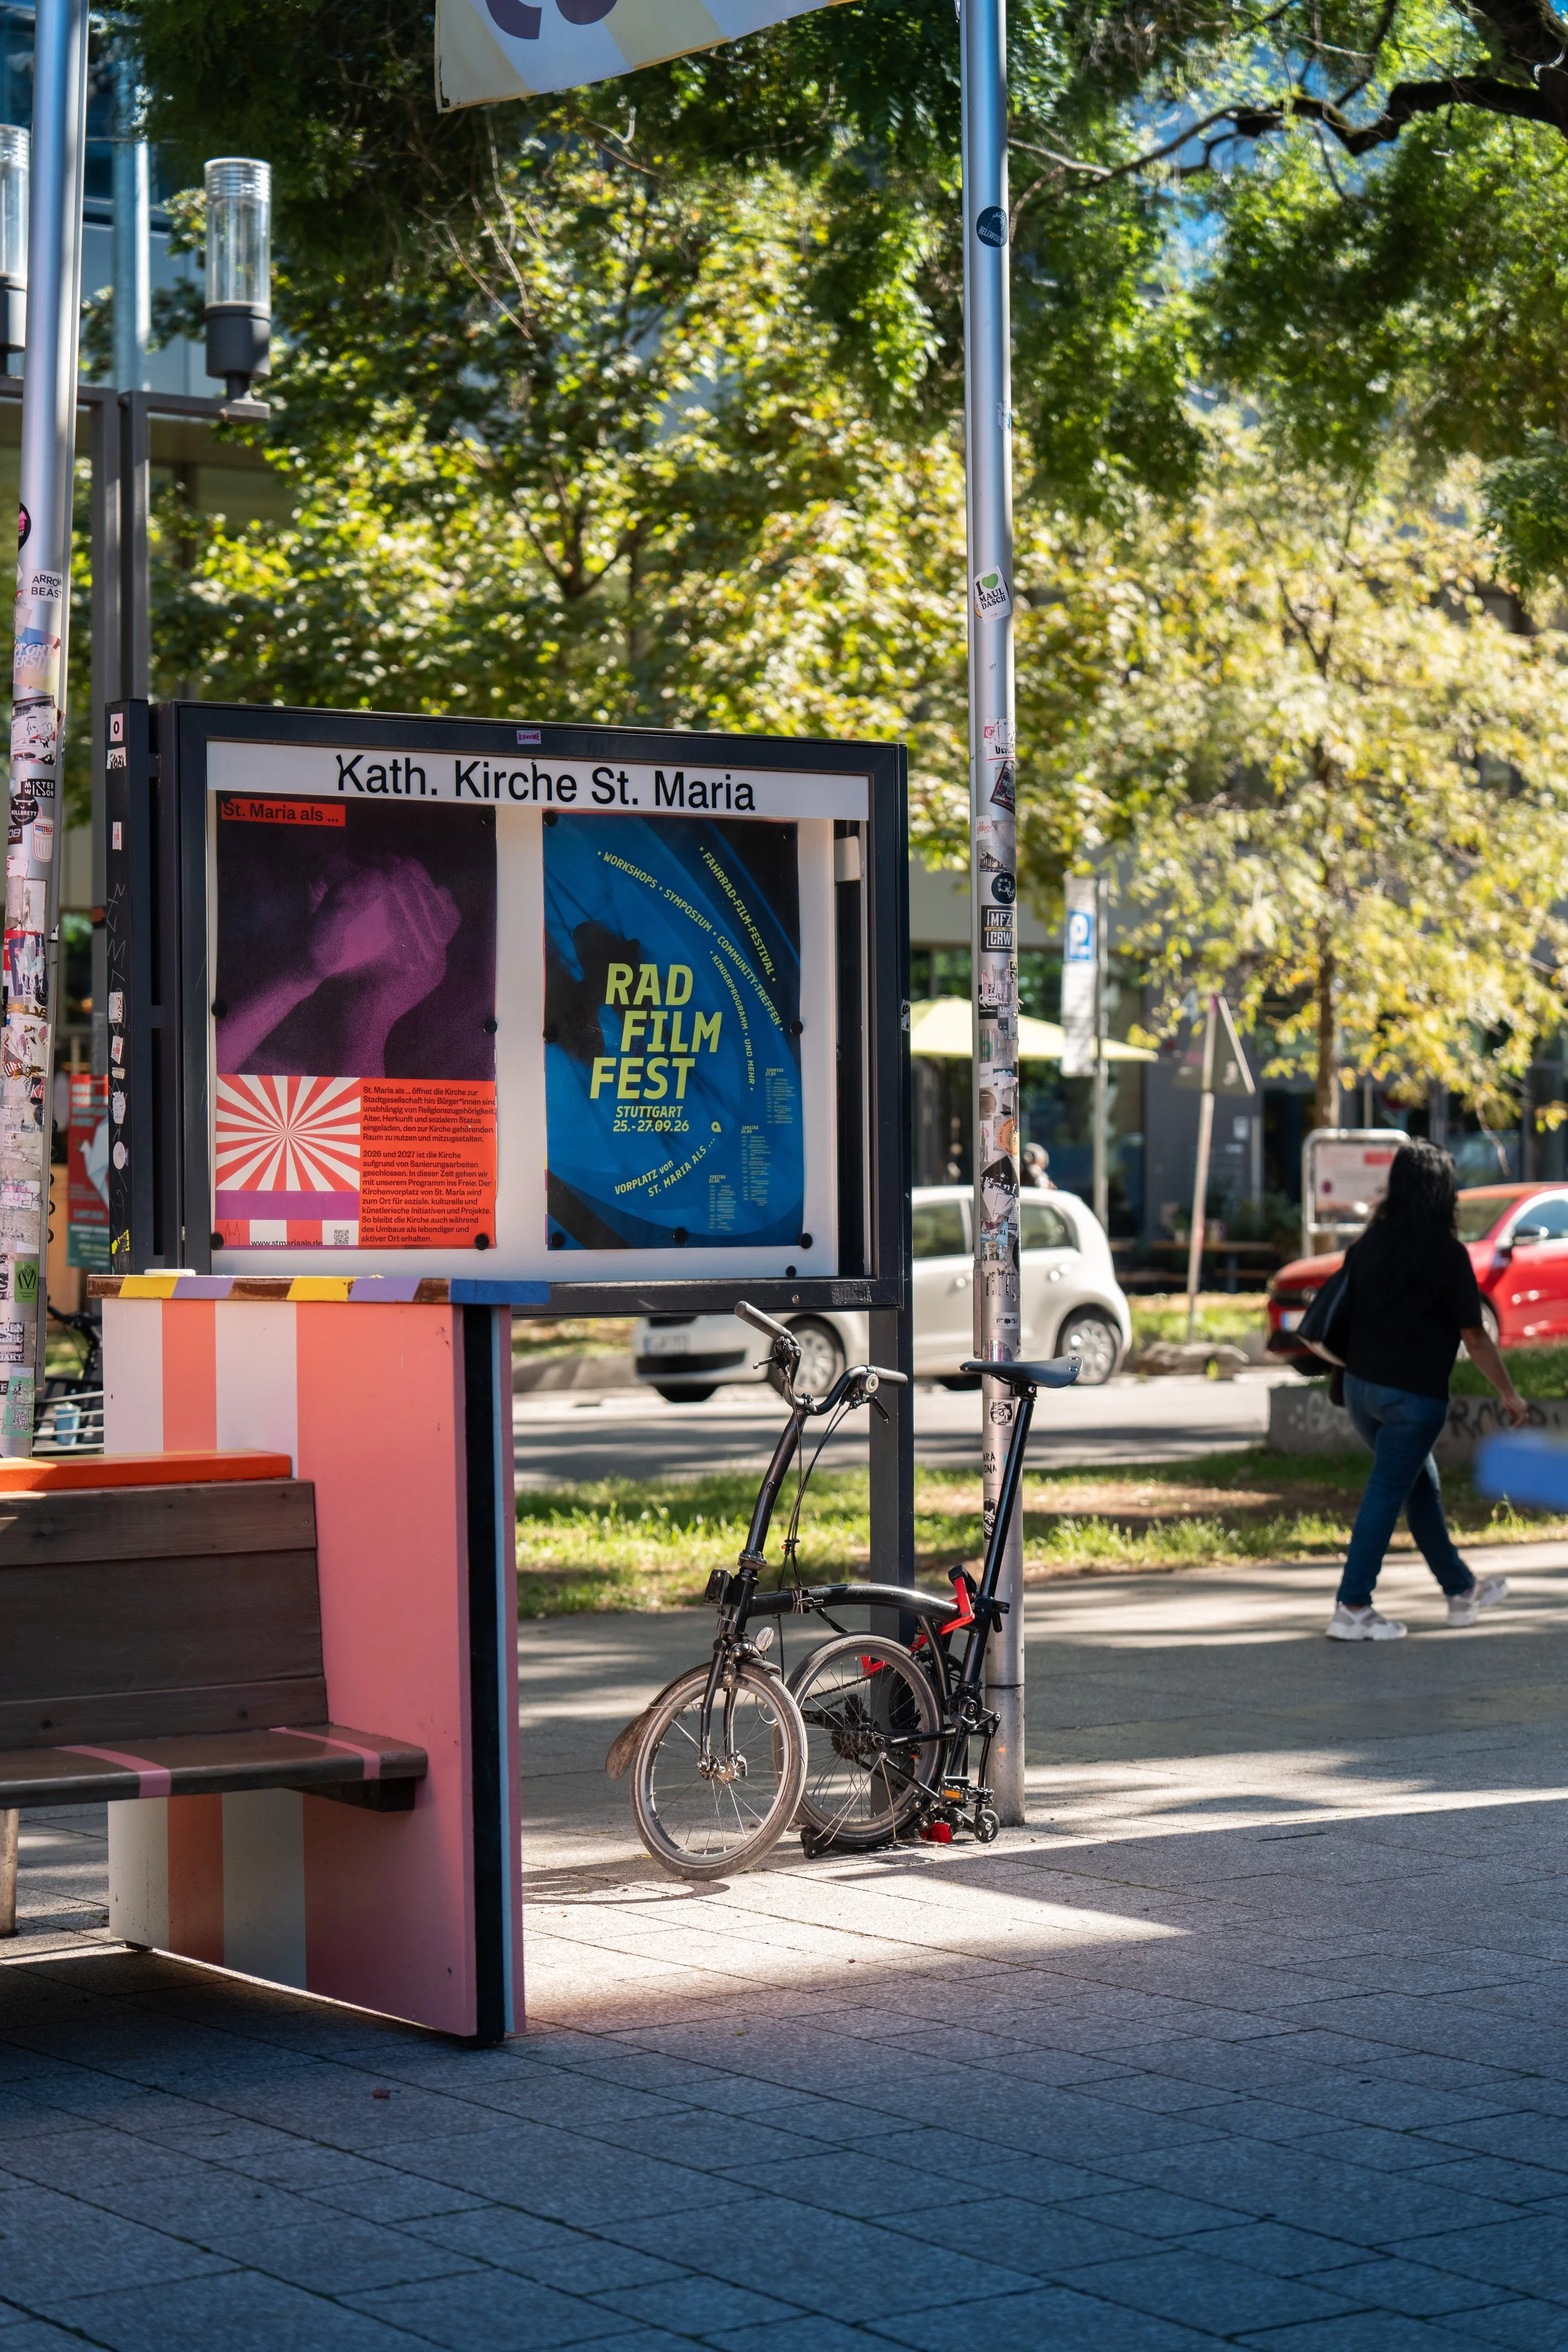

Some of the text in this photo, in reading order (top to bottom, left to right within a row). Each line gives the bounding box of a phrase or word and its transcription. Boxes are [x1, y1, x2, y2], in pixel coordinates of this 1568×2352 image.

[32, 574, 62, 587] ARROW
[975, 580, 983, 596] I
[31, 586, 61, 599] BEAST
[979, 588, 1005, 604] MAUL
[981, 596, 1006, 610] DASCH
[337, 755, 755, 810] Kath. Kirche St. Maria
[223, 801, 246, 817] St.
[250, 803, 296, 820] Maria
[300, 806, 323, 822] als
[702, 852, 774, 976] FAHRRAD-FILM-FESTIVAL
[603, 852, 782, 1026] WORKSHOPS SYMPOSIUM COMMUNITY-TREFFEN
[605, 963, 693, 1005] RAD
[712, 955, 748, 1030] KINDERPROGRAMM
[744, 1039, 753, 1057] UND
[621, 1010, 722, 1053] FILM
[590, 1057, 695, 1099] FEST
[364, 1106, 403, 1114] unabhängig
[616, 1106, 682, 1118] STUTTGART
[452, 1126, 493, 1134] gehörenden
[410, 1160, 478, 1169] Sanierungsarbeiten
[648, 1184, 662, 1197] ST.
[663, 1162, 692, 1188] MARIA
[691, 1145, 707, 1164] ALS
[409, 1179, 445, 1187] Programm
[615, 1160, 674, 1195] VORPLATZ von
